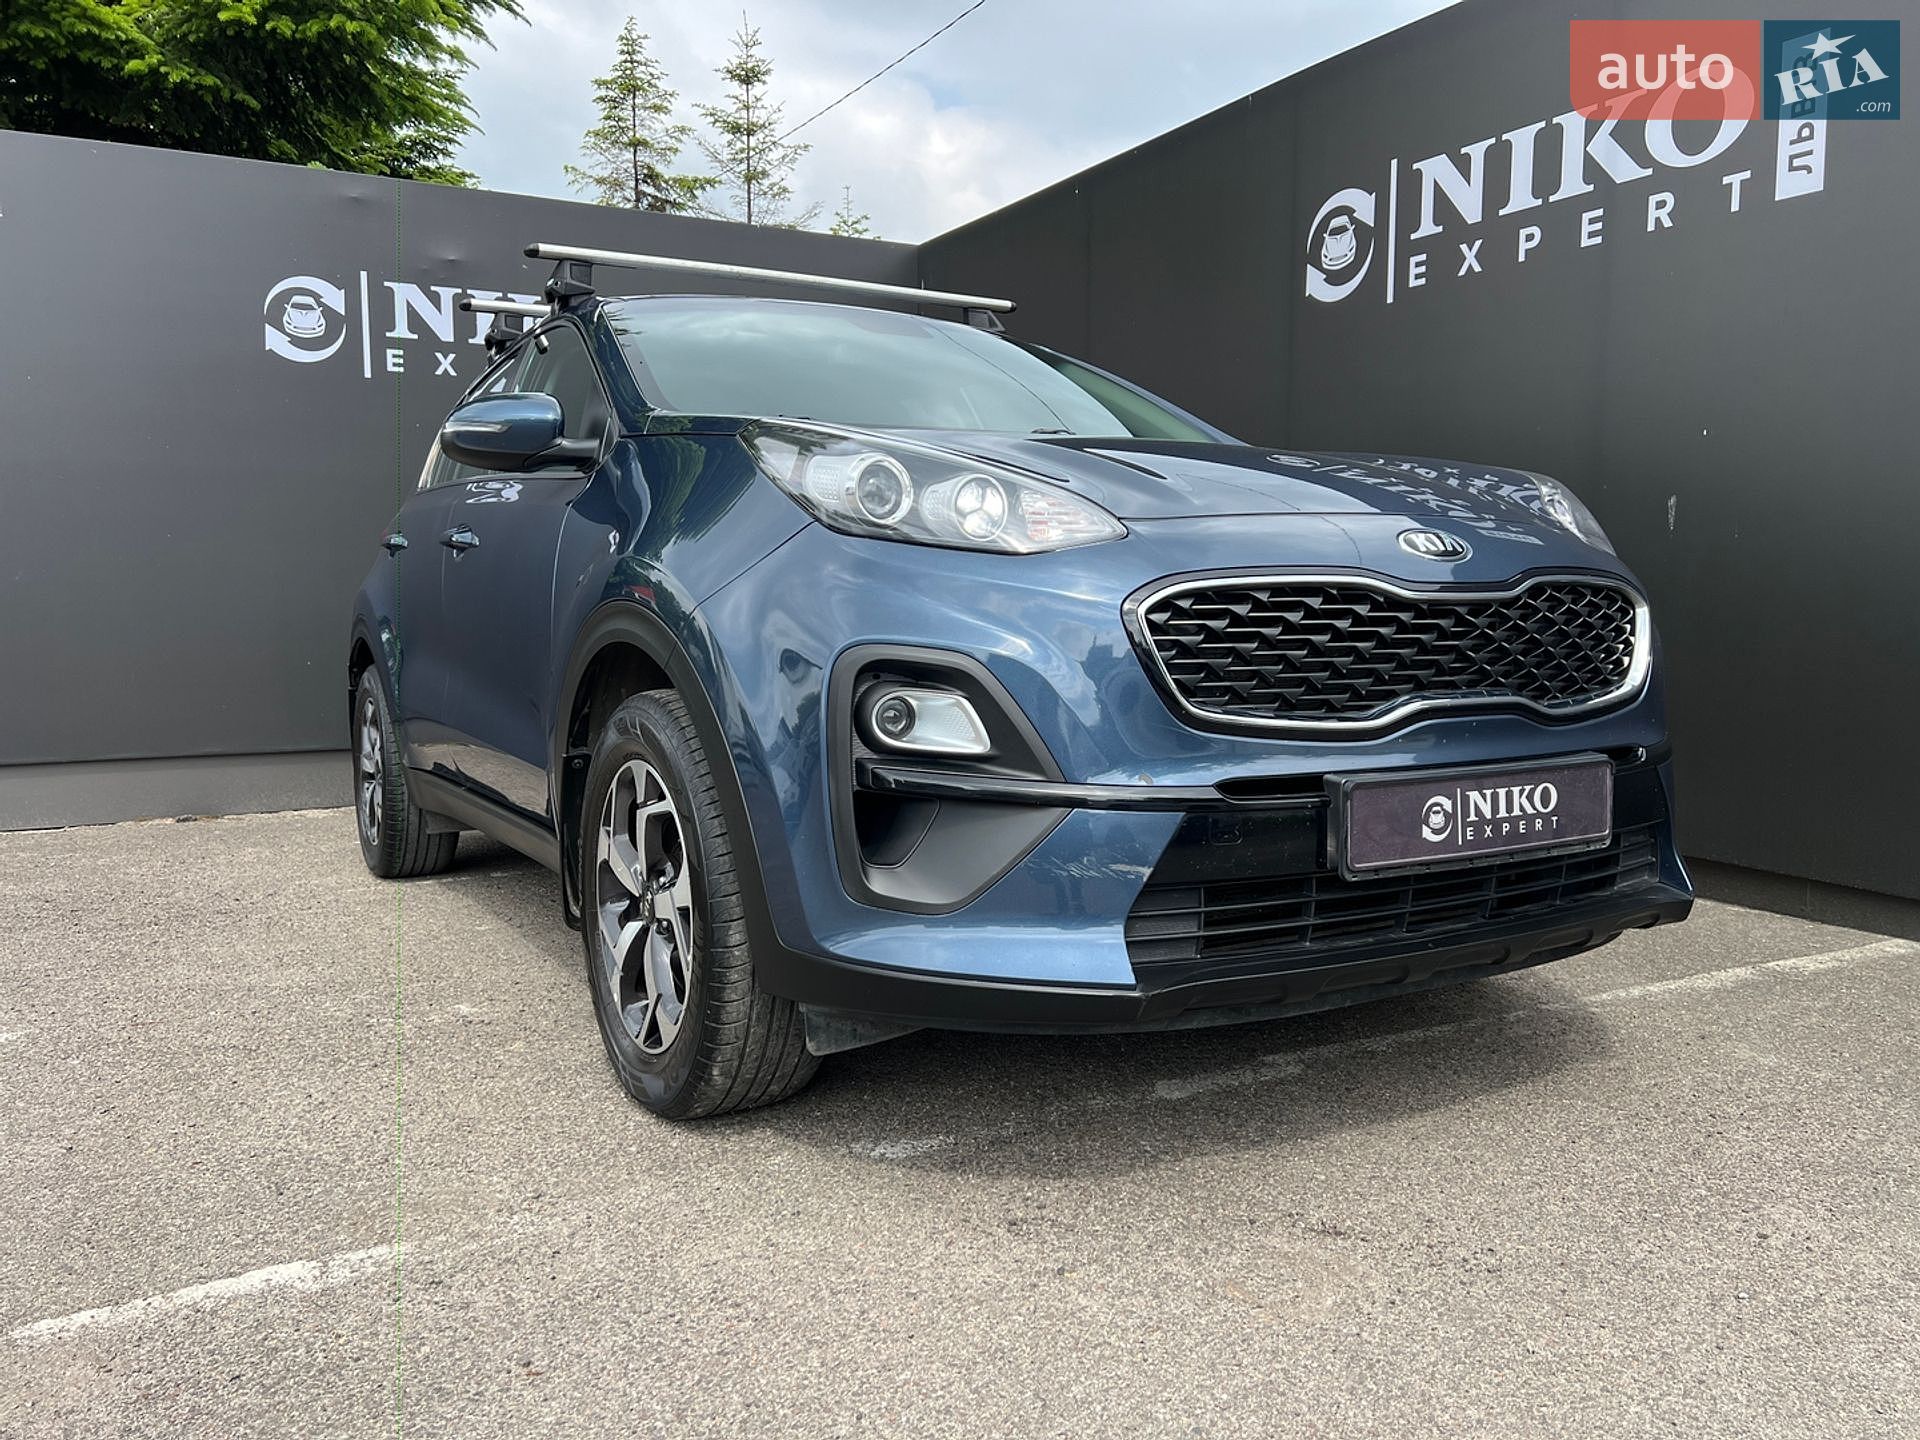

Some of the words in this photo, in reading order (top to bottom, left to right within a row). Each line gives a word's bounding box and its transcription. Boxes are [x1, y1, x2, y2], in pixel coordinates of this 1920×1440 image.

[1410, 66, 1755, 240] NIKO
[1409, 170, 1752, 288] EXPERT
[1466, 782, 1558, 822] NIKO
[1467, 816, 1558, 840] EXPERT
